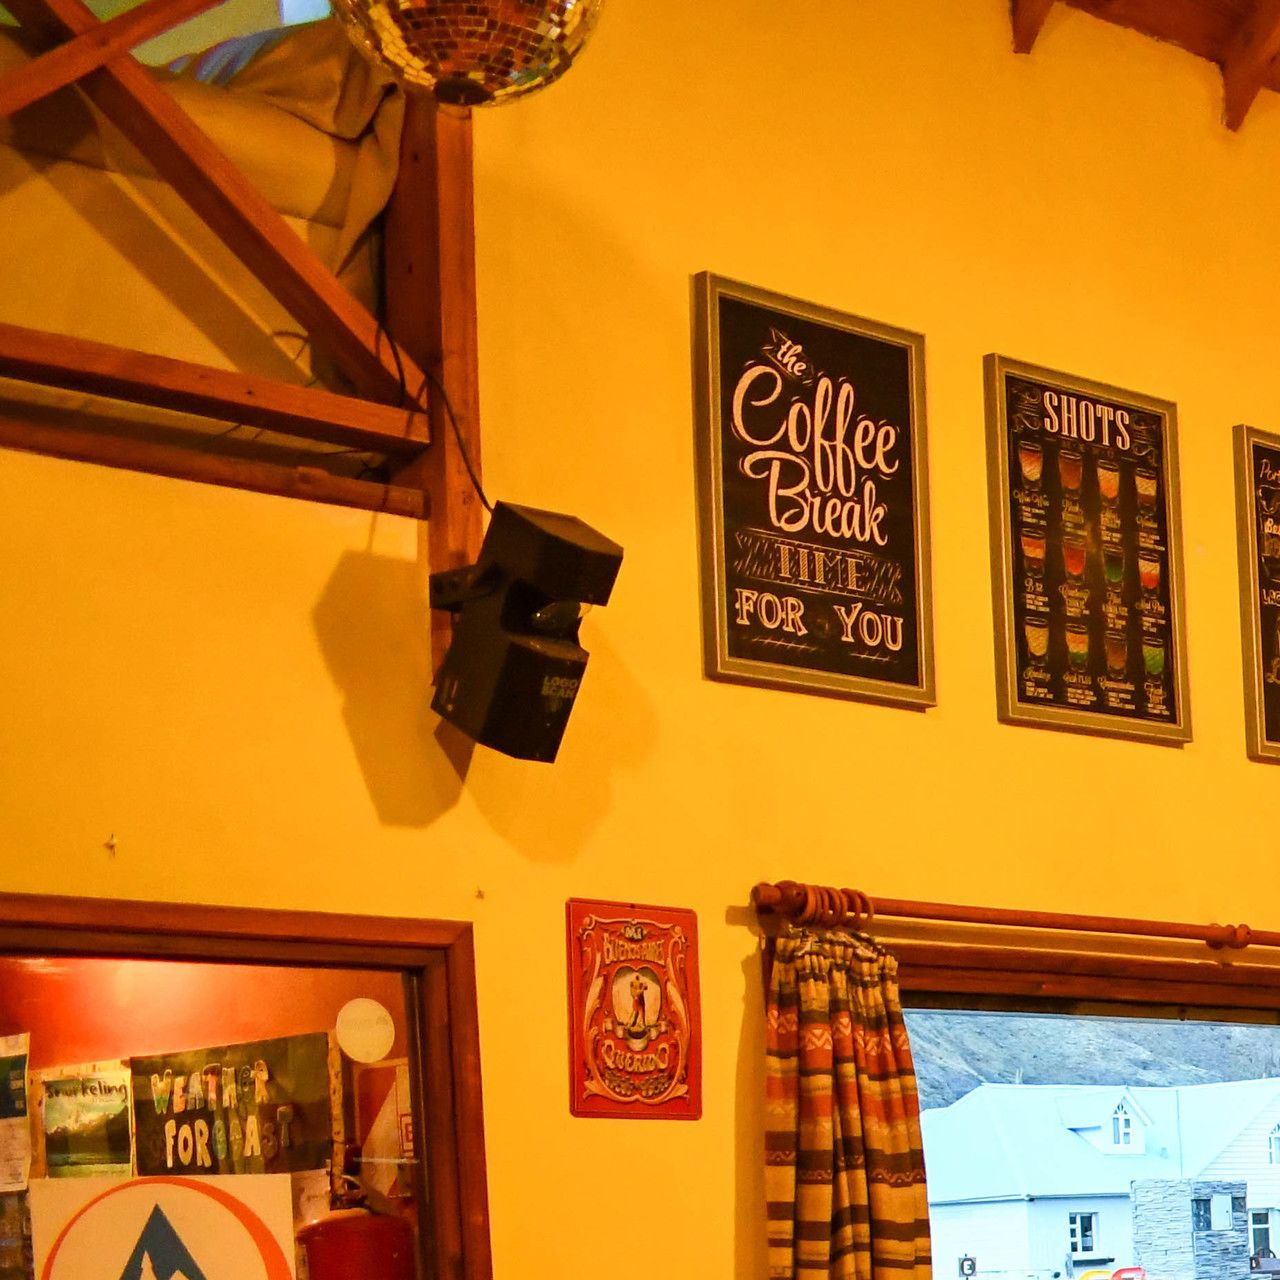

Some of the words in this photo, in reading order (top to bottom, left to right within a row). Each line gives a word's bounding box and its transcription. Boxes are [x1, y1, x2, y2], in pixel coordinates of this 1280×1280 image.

[776, 339, 808, 377] the
[732, 365, 900, 497] Coffee
[1043, 391, 1132, 450] SHOTS
[743, 450, 888, 546] Break
[775, 542, 867, 593] TIME
[735, 588, 808, 635] FOR
[833, 602, 904, 652] YOU
